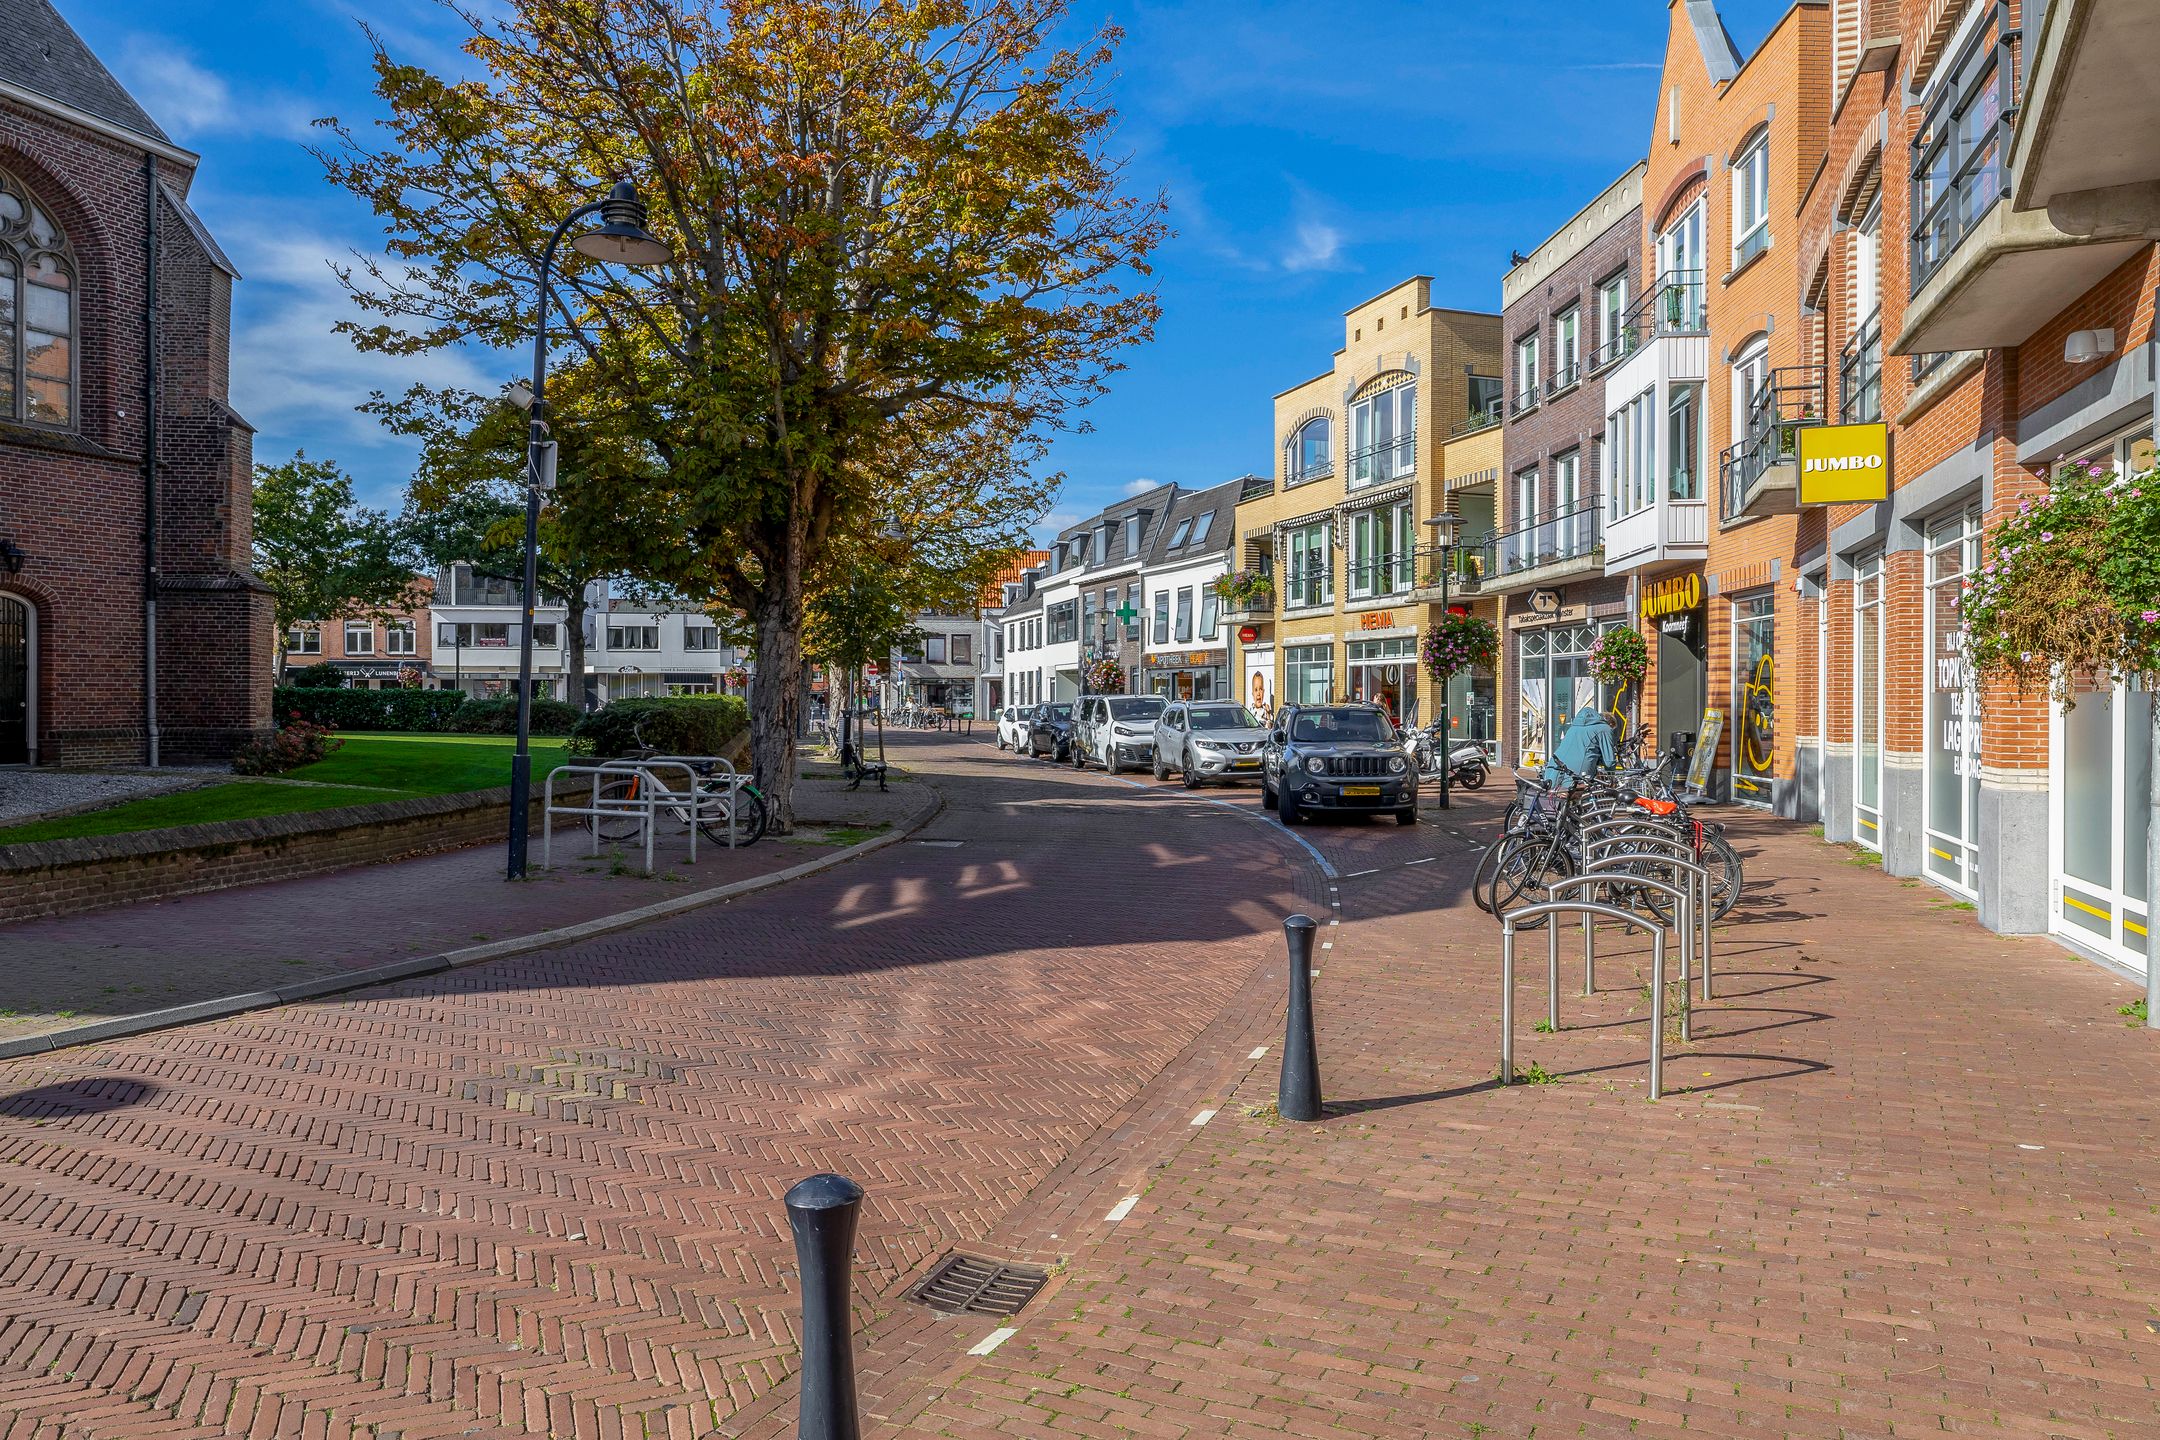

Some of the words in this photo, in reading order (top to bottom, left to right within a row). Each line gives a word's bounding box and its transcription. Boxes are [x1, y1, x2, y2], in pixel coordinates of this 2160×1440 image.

[1803, 454, 1883, 473] JUMBO
[1640, 572, 1700, 618] JUMBO
[1359, 611, 1396, 631] HEMA
